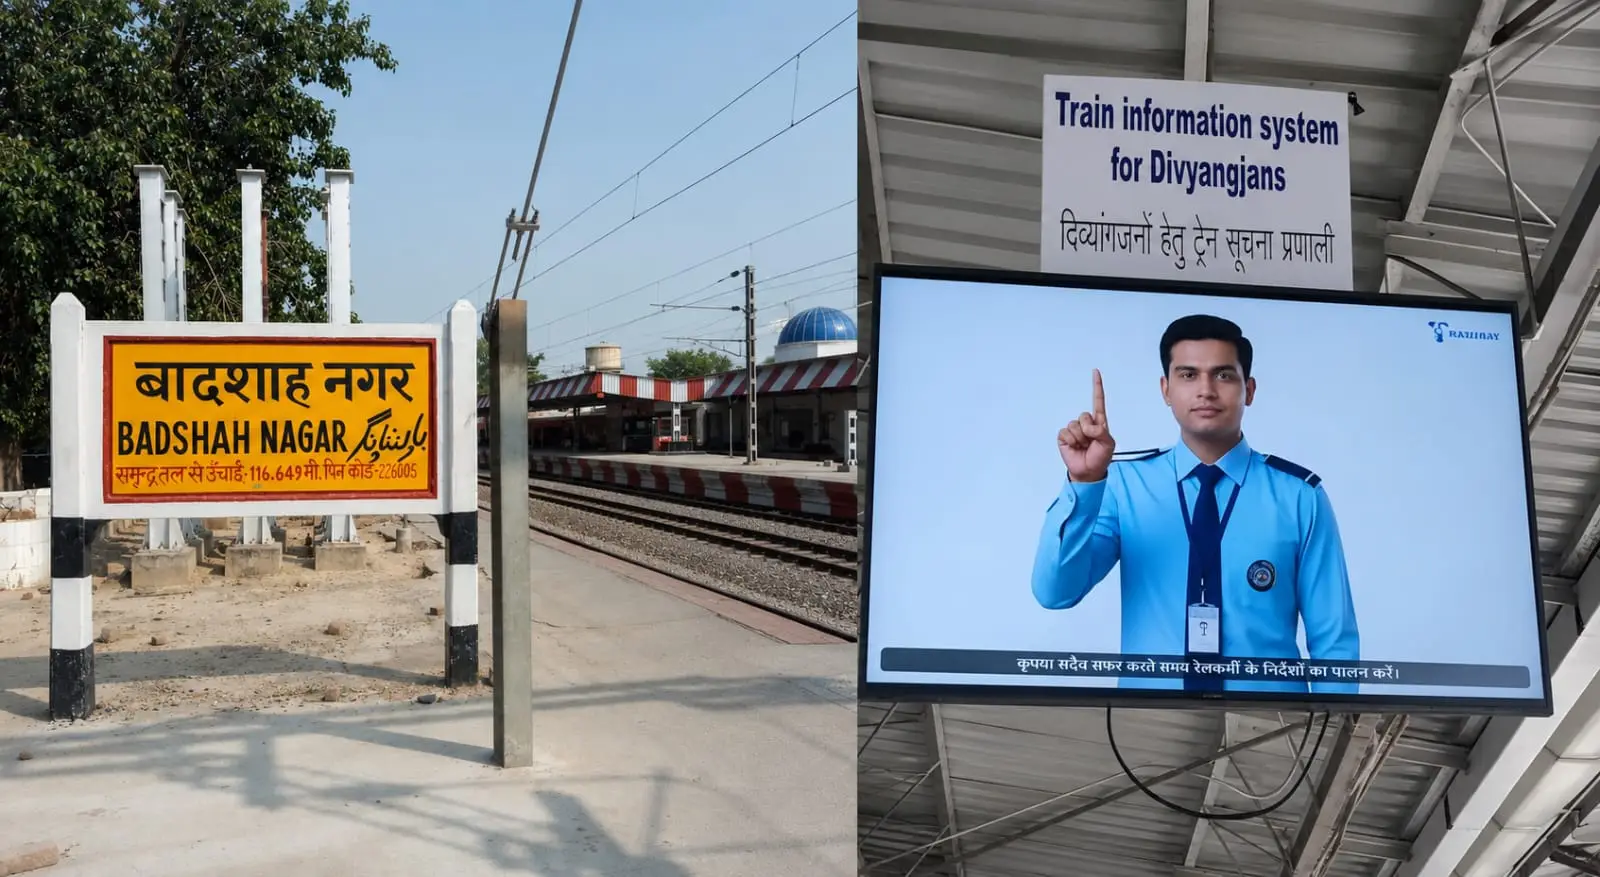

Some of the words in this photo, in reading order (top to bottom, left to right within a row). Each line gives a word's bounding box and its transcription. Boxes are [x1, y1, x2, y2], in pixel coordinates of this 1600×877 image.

[1055, 92, 1114, 129] Train
[1123, 95, 1252, 139] information
[1259, 112, 1339, 150] system
[1111, 146, 1143, 182] for
[1151, 149, 1287, 197] Divyangjans
[1060, 208, 1153, 255] दिव्यांगजनों
[1160, 211, 1187, 270] हेतु
[1192, 214, 1219, 268] ट्रेन
[1225, 228, 1274, 274] सूचना
[1281, 222, 1335, 264] प्रणाली
[134, 362, 314, 409] बादशाह
[324, 362, 416, 402] नगर
[117, 420, 250, 456] BADSHAH
[260, 420, 349, 454] NAGAR
[188, 460, 204, 483] से
[250, 465, 302, 482] 116.649
[303, 461, 322, 481] मी.
[324, 457, 347, 481] पिन
[1017, 657, 1053, 673] कृपया
[1058, 654, 1089, 672] सदैव
[1091, 660, 1122, 672] सफर
[1126, 658, 1156, 673] करते
[1159, 661, 1189, 673] समय
[1244, 660, 1259, 675] के
[1309, 664, 1327, 677] का
[1331, 666, 1369, 679] पालन
